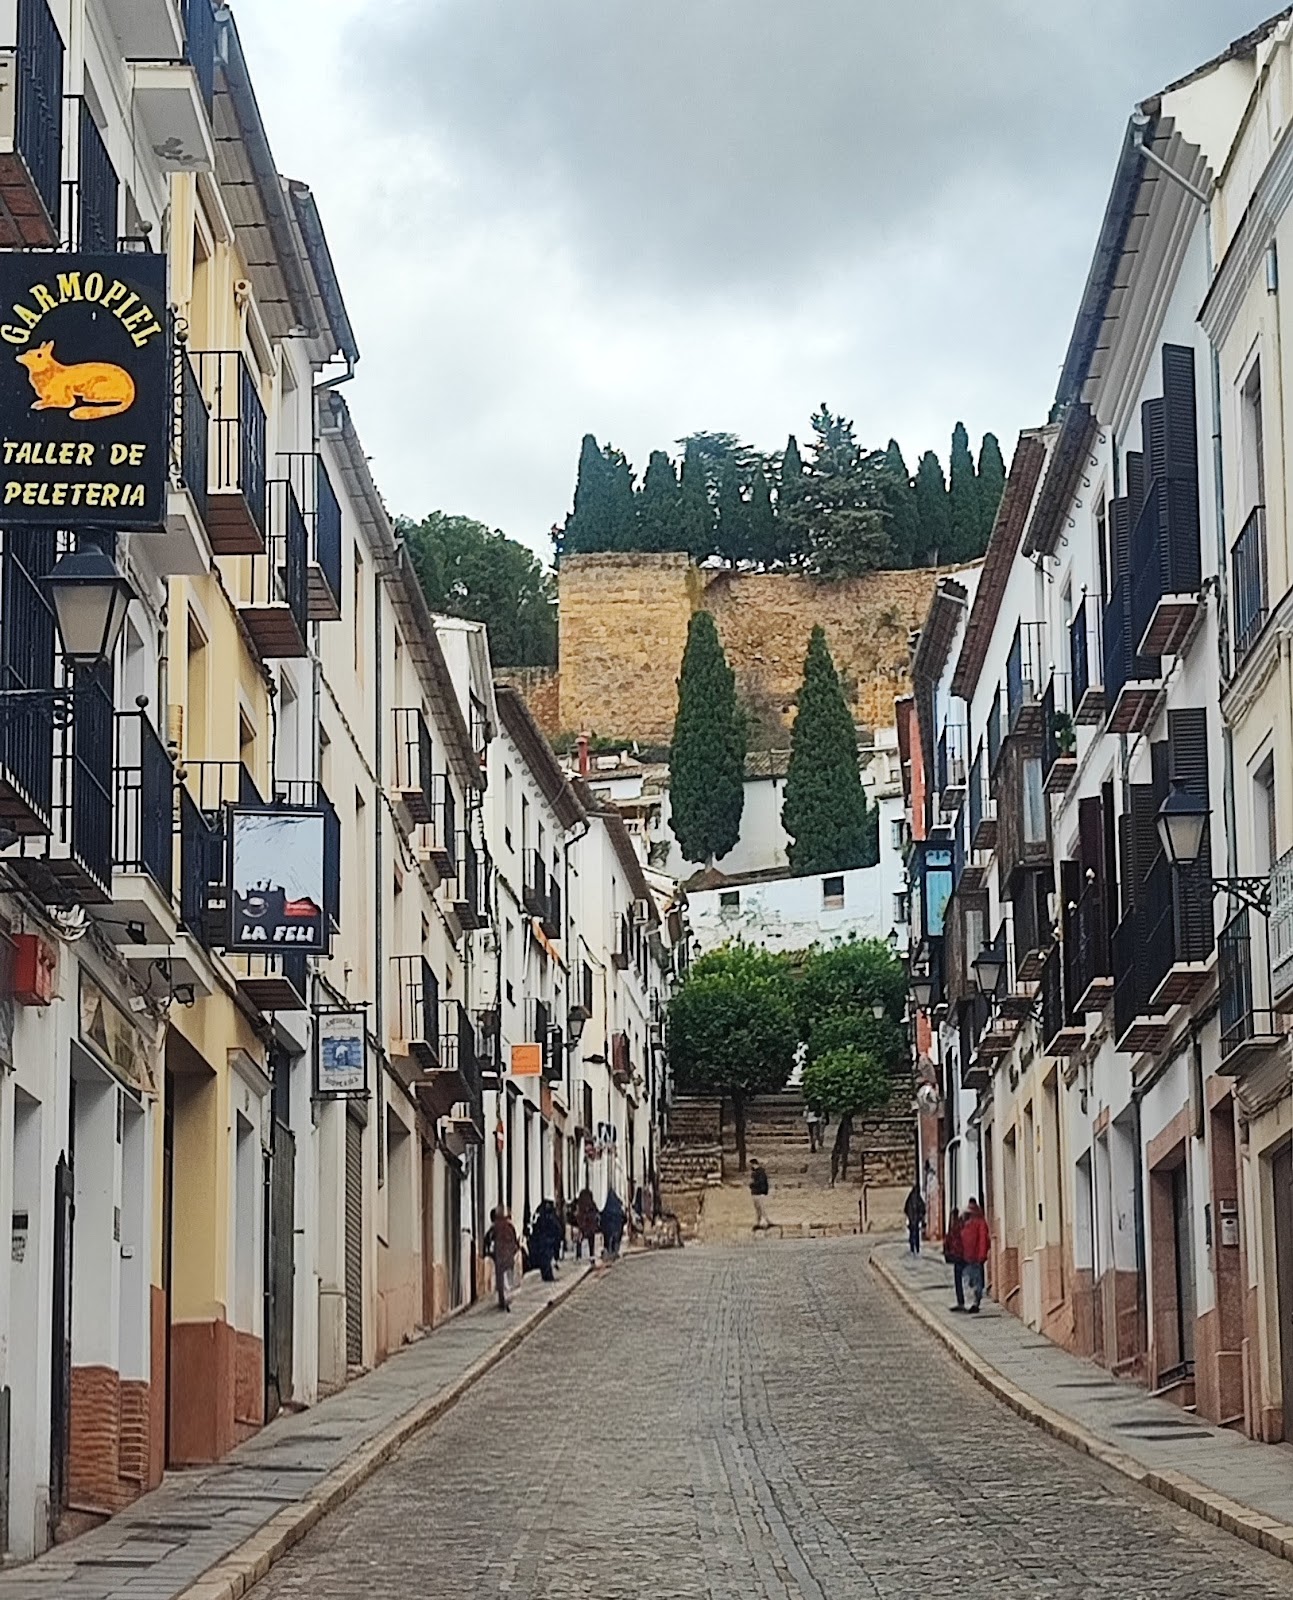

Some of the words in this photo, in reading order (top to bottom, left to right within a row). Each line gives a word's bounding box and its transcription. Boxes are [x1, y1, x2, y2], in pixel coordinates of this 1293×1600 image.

[0, 271, 162, 348] GARMOPIEL
[3, 442, 95, 466] TALLER
[110, 443, 146, 466] DE
[4, 481, 145, 507] PELETERIA
[241, 924, 268, 941] LA
[273, 925, 315, 943] FELI
